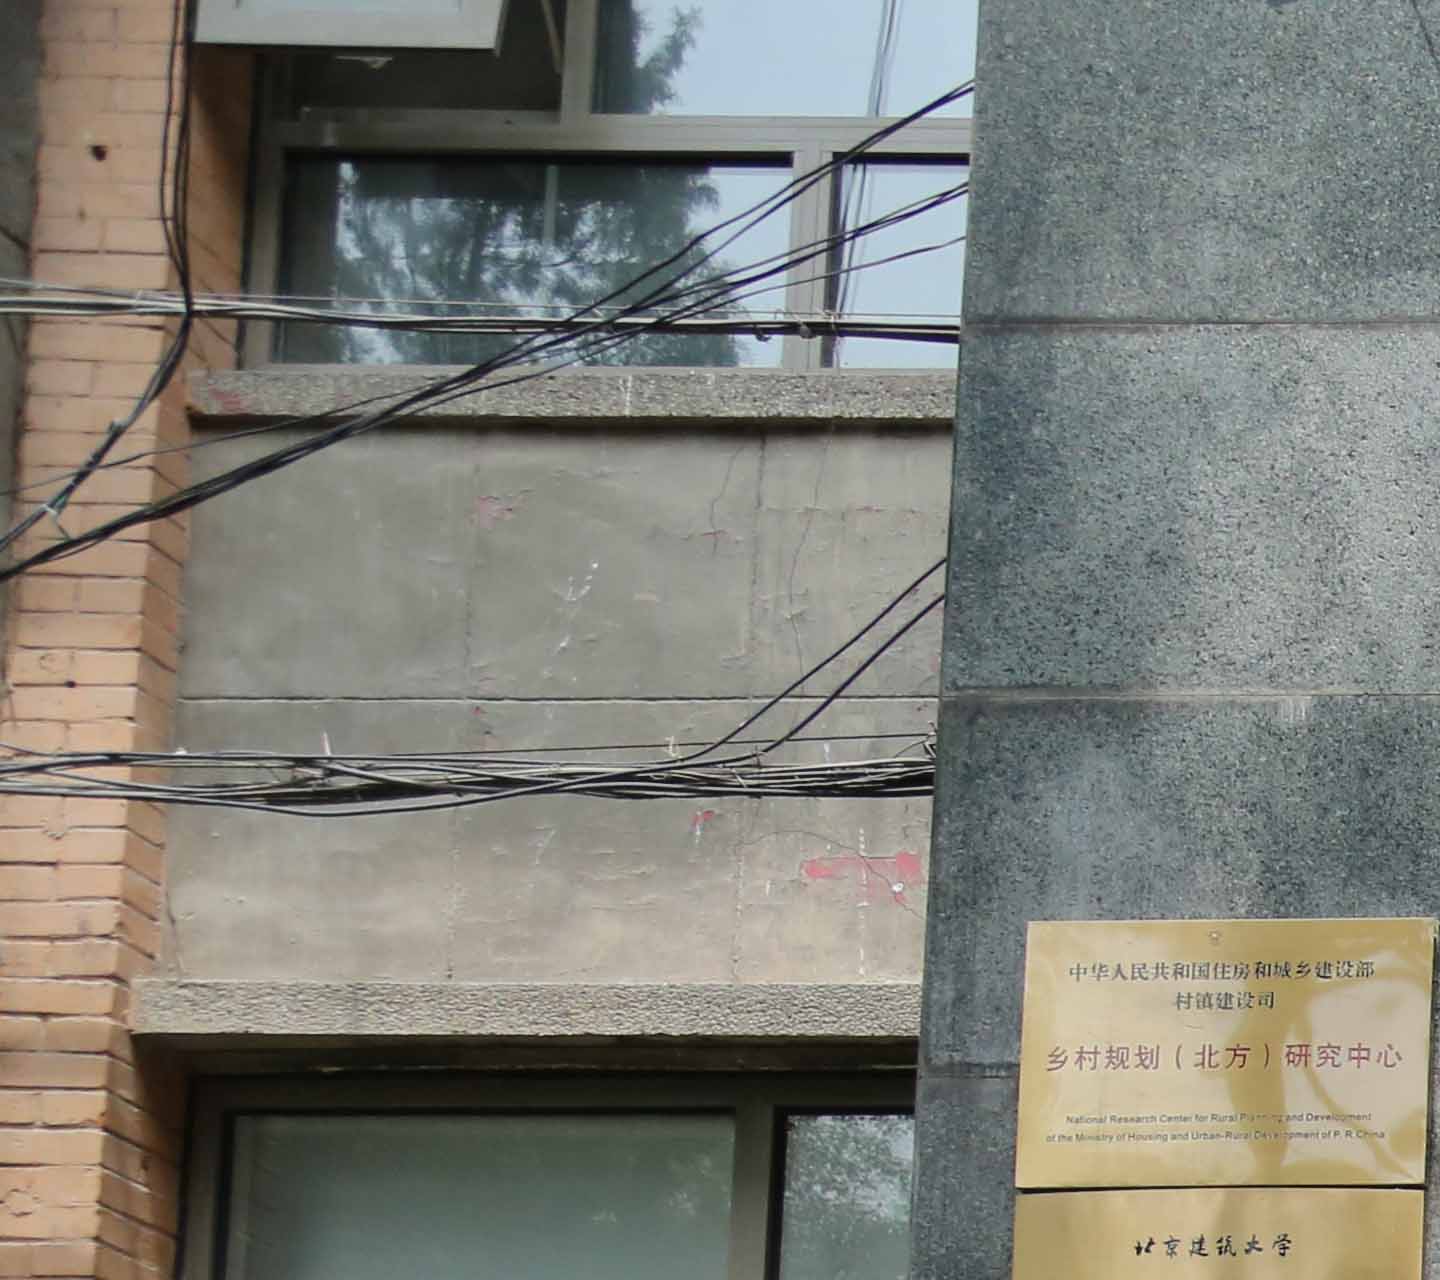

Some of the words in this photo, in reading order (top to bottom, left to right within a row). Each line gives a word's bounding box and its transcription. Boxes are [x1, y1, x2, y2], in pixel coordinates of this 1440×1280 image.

[1069, 960, 1375, 982] 中华人民共和国住房和城乡建设部
[1175, 991, 1275, 1010] 村镇建设司
[1133, 1233, 1294, 1259] 北京建筑大学
